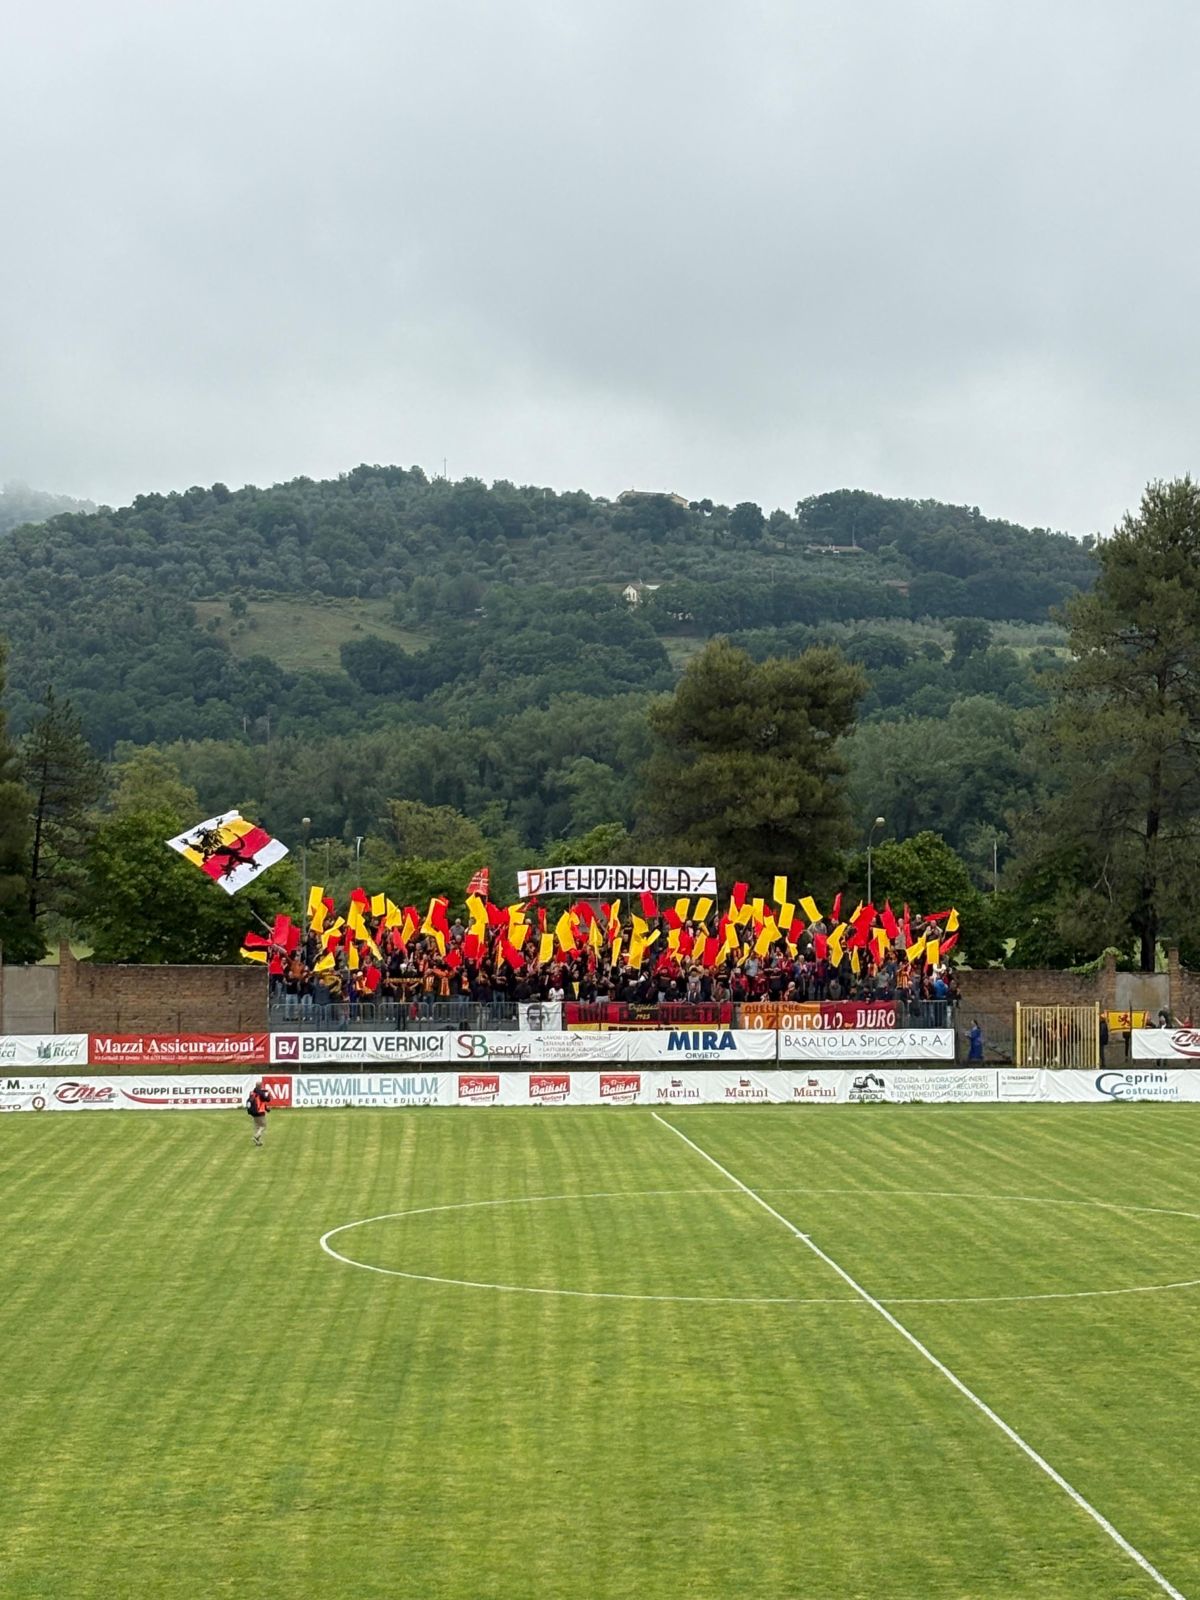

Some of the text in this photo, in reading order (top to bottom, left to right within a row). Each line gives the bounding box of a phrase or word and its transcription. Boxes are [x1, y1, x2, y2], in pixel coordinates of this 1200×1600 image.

[856, 1009, 896, 1028] DURO
[94, 1038, 254, 1054] Mazzi Assicurazioni
[303, 1036, 444, 1052] BRUZZI VERNICI
[457, 1034, 531, 1058] SB servizi
[667, 1031, 737, 1050] MIRA
[784, 1034, 947, 1047] BASALTO LA SPICCA S.P.A.
[53, 1046, 79, 1057] Ricci
[132, 1086, 242, 1095] GRUPPI ELETTROGENI
[296, 1077, 438, 1096] NEWMILLENIUM
[794, 1087, 836, 1097] Marini
[1095, 1073, 1168, 1095] Ceprini
[1111, 1083, 1178, 1099] Costruzioni
[296, 1097, 351, 1105] SOLUZIONI
[383, 1096, 438, 1104] L'EDILIZIA
[657, 1088, 699, 1098] Marini
[725, 1088, 768, 1097] Marini
